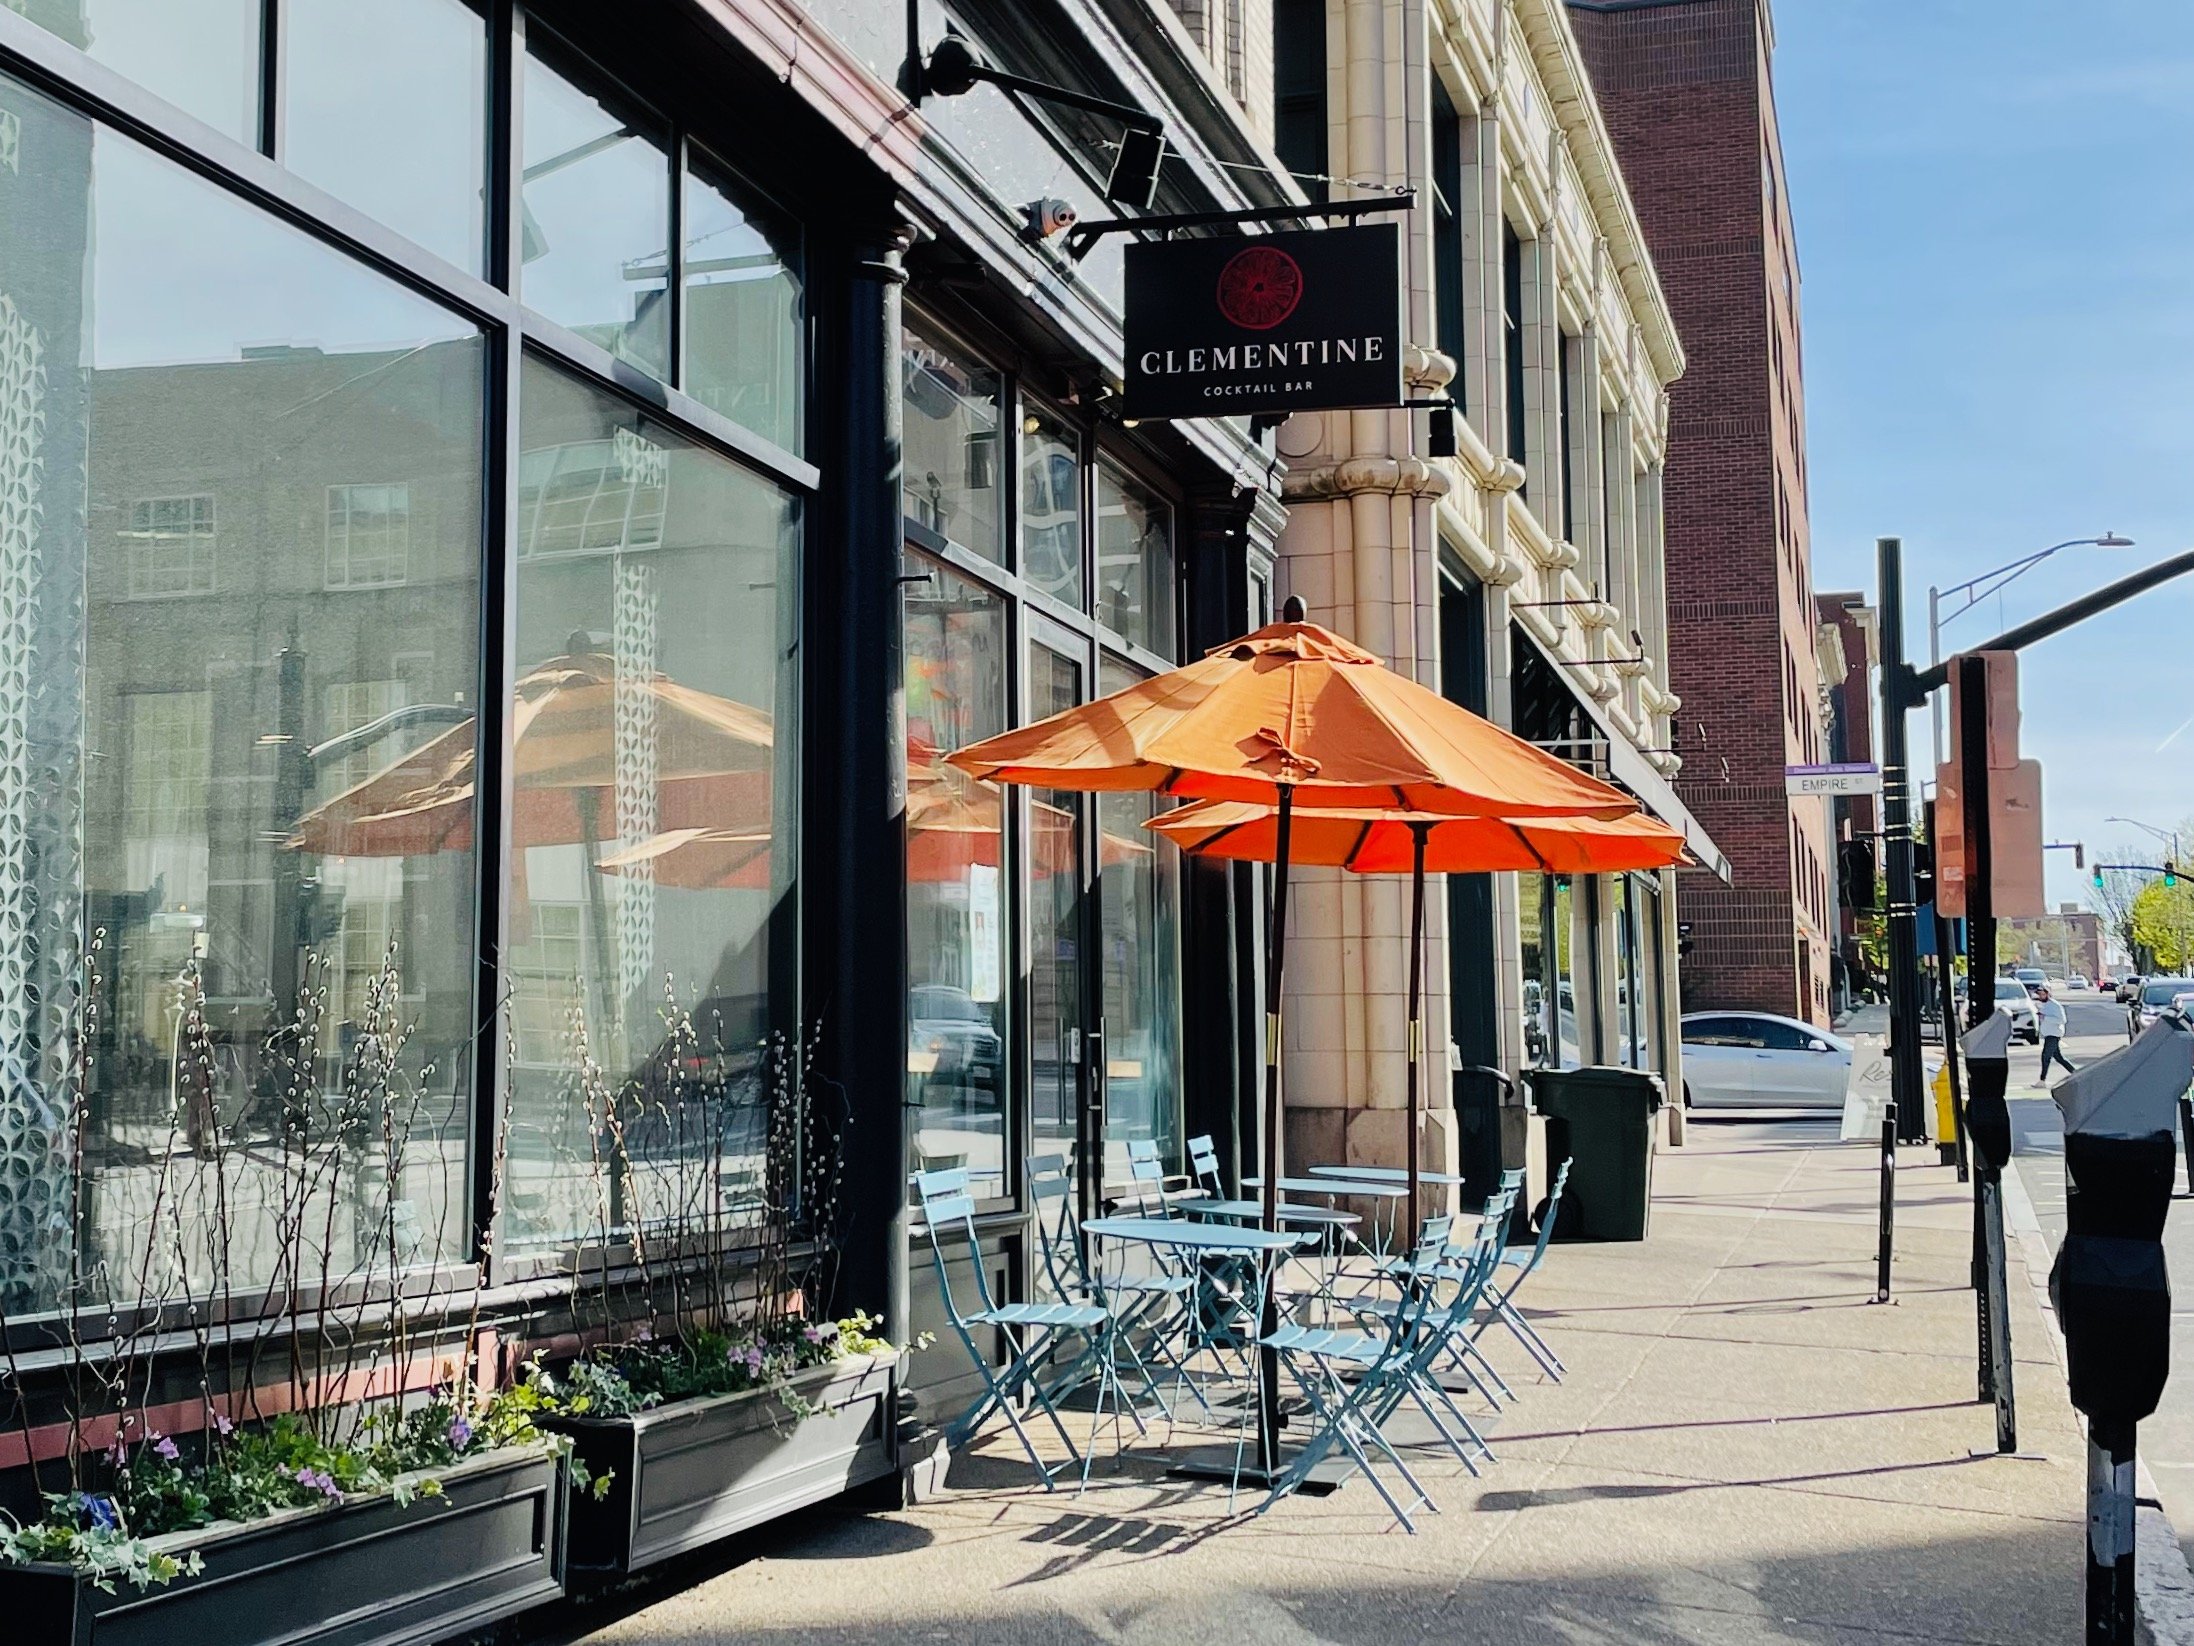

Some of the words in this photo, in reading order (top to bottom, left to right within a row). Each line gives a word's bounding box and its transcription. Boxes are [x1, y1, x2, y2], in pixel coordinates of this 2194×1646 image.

[1140, 336, 1383, 375] CLEMENTINE
[1203, 383, 1276, 397] COCKTAIL
[1285, 381, 1313, 392] BAR
[1801, 778, 1849, 791] EMPIRE
